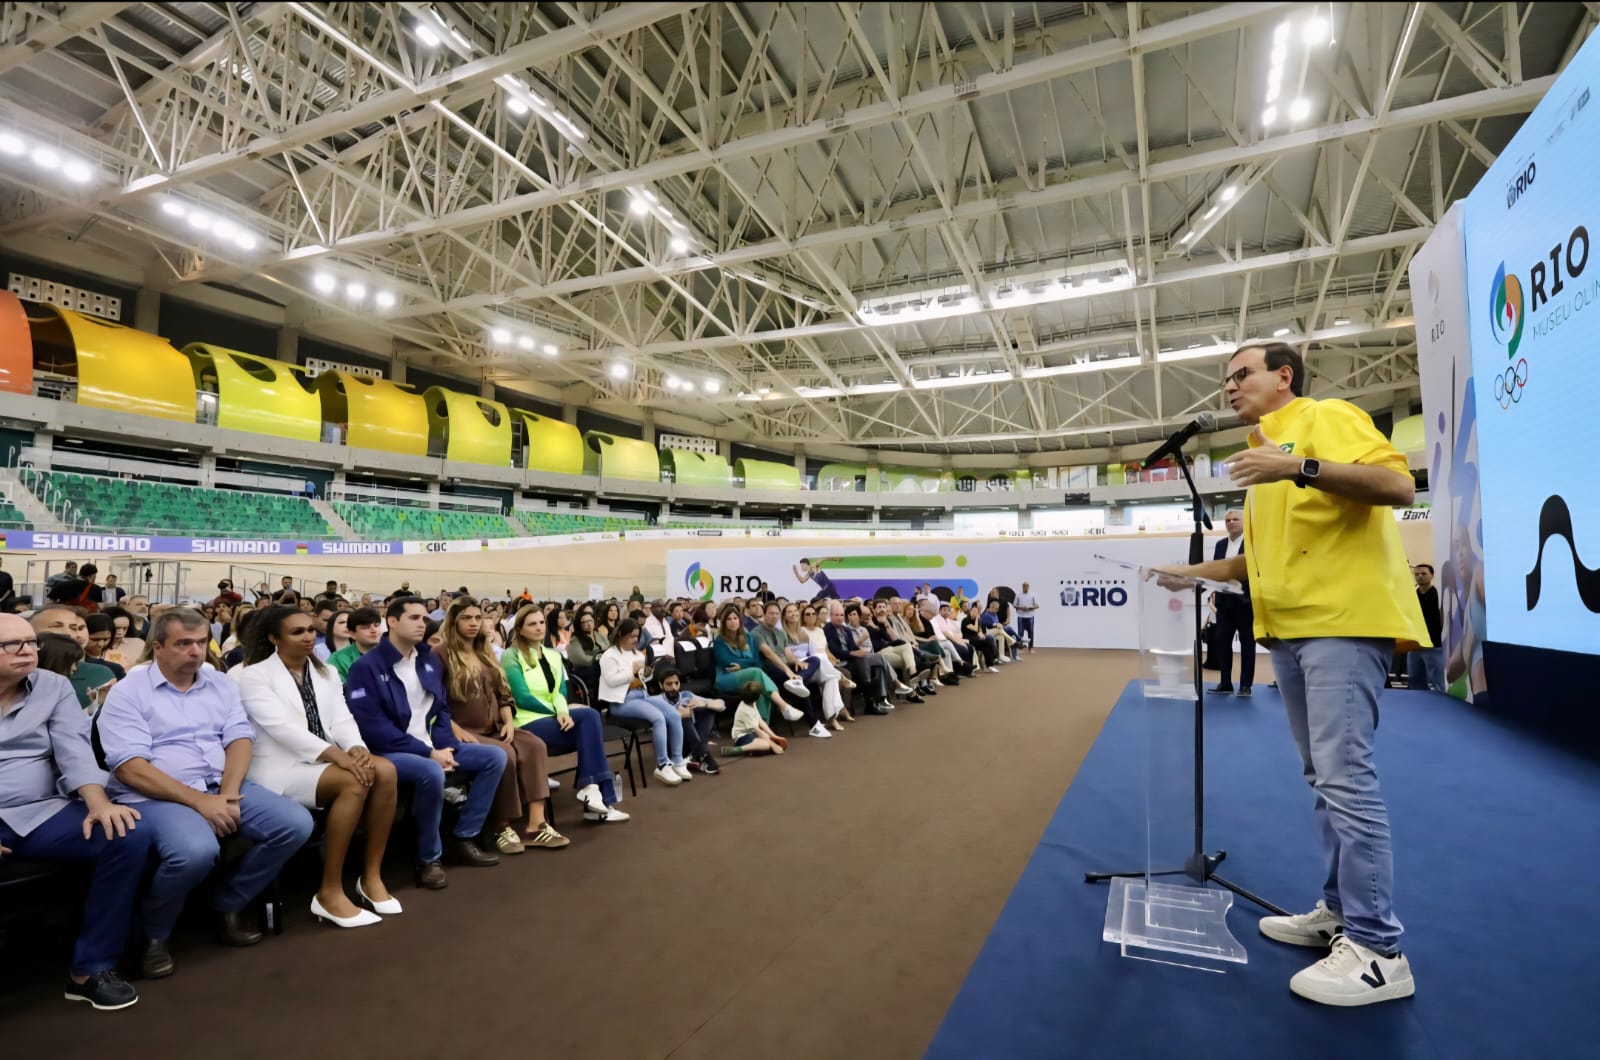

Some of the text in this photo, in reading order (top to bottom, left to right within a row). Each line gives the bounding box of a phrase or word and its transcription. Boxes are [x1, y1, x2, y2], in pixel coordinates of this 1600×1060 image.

[1516, 162, 1536, 200] RIO
[1530, 225, 1589, 313] RIO
[1532, 300, 1572, 341] MUSEU
[1431, 319, 1445, 344] RIO
[32, 533, 151, 552] SHIMANO
[191, 539, 280, 553] SHIMANO
[322, 542, 391, 554] SHIMANO
[426, 542, 447, 552] CBC
[720, 575, 762, 593] RIO
[1082, 587, 1128, 607] RIO
